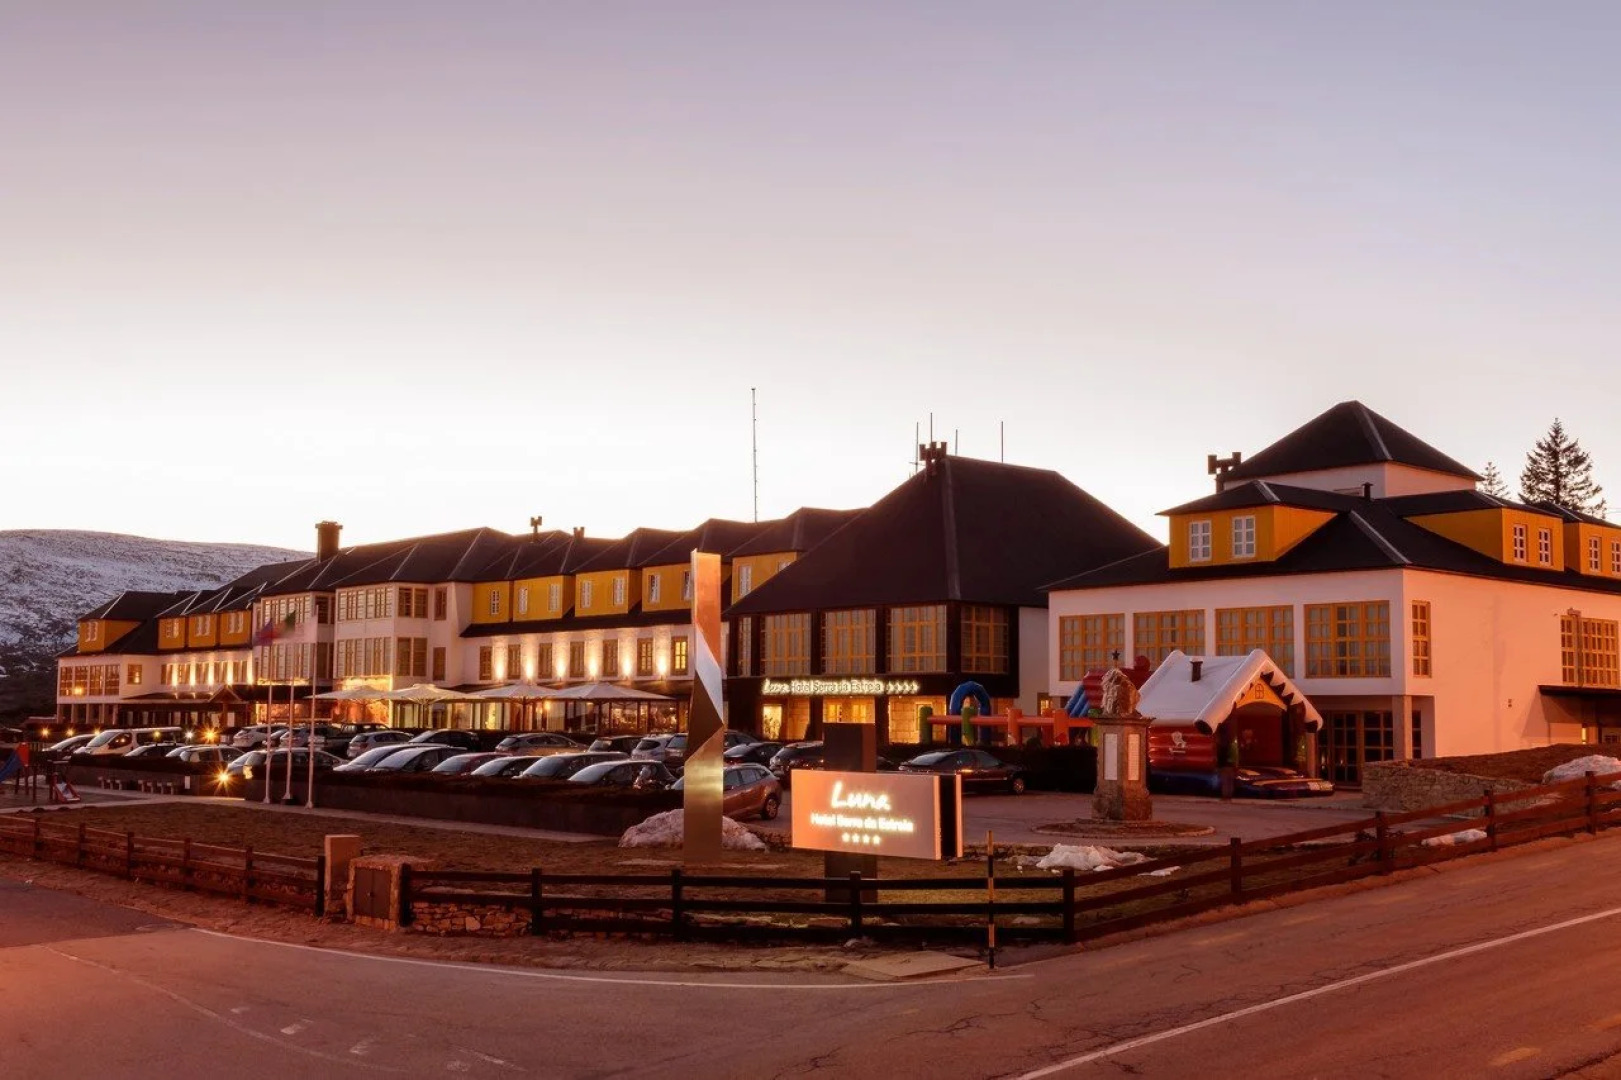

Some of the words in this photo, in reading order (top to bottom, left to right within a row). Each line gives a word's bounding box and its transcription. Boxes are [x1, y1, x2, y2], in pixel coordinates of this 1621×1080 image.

[791, 680, 813, 694] Hotel
[814, 680, 839, 694] Serra
[840, 679, 850, 693] da
[851, 679, 883, 694] Estrela
[831, 781, 891, 810] Luna
[810, 813, 836, 827] Hotel
[836, 814, 863, 829] Serra
[864, 817, 877, 829] da
[878, 817, 914, 832] Estrela
